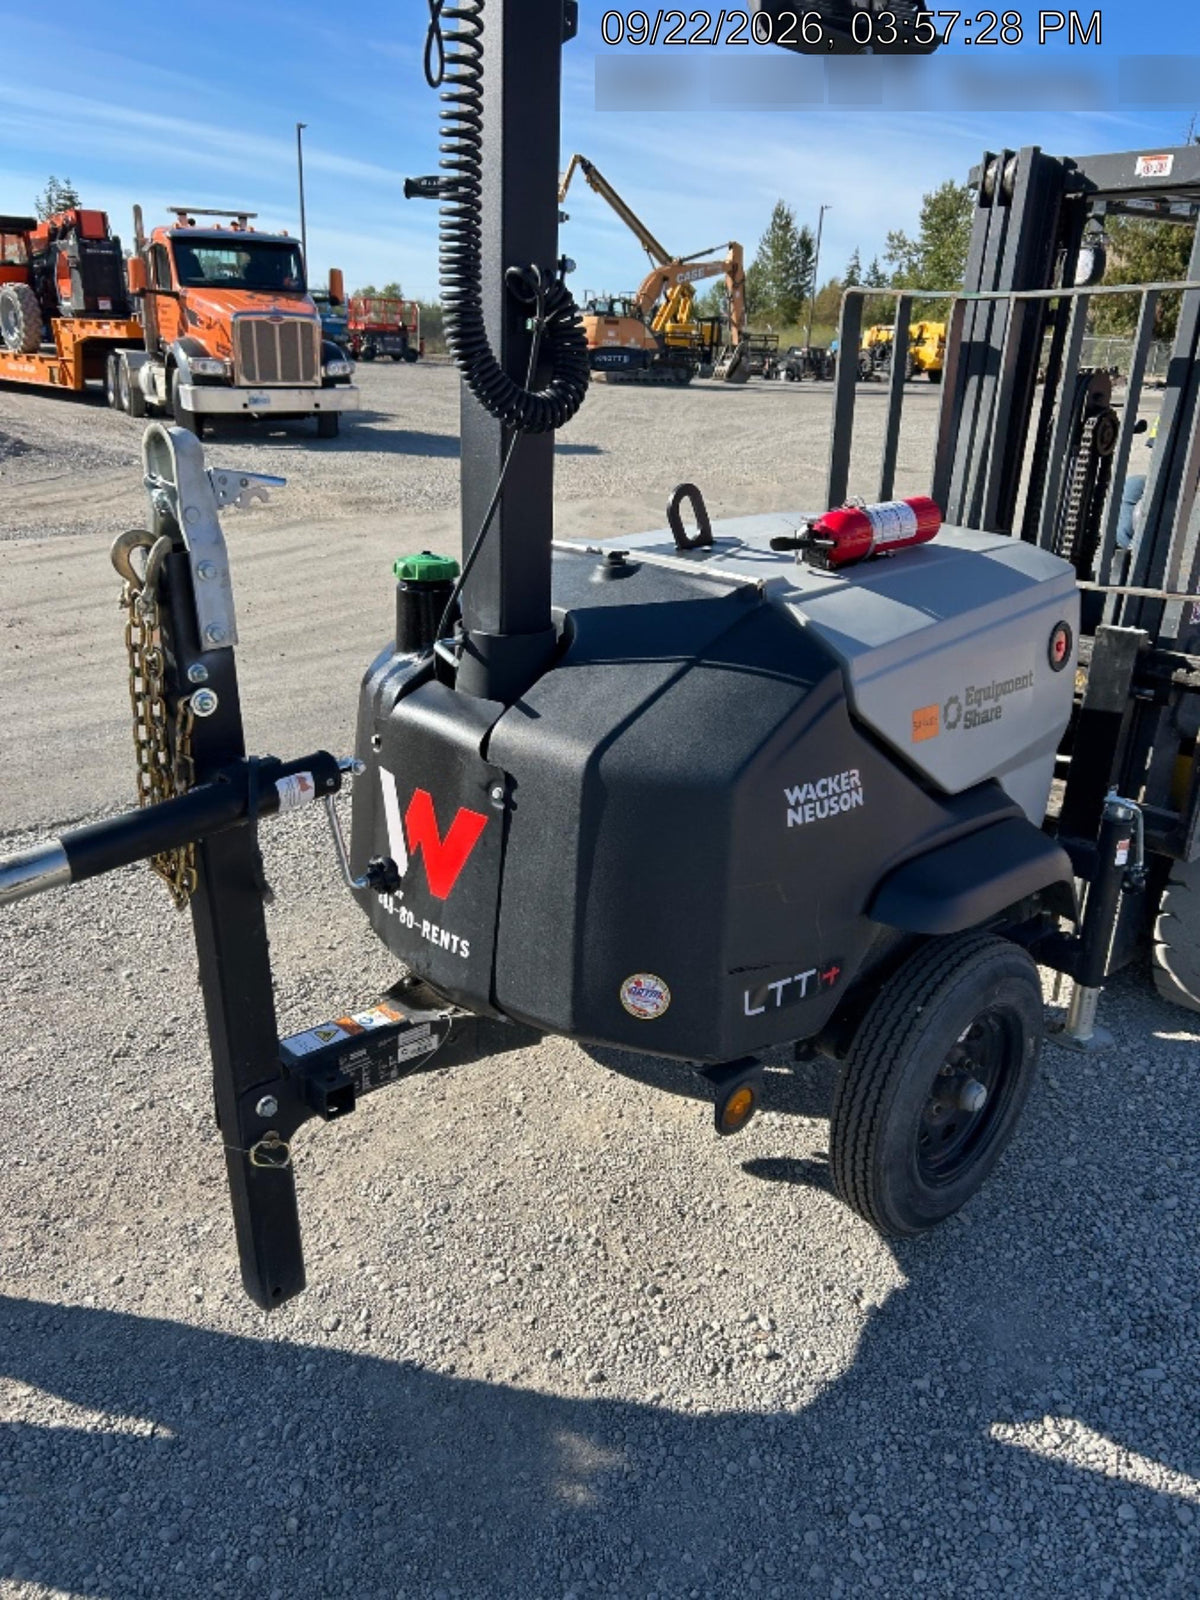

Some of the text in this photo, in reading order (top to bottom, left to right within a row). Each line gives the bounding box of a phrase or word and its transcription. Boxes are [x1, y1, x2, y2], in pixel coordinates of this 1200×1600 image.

[676, 266, 706, 284] CASE
[965, 669, 1034, 708] Equipment
[963, 705, 1002, 730] Share
[784, 769, 861, 807] WACKER
[786, 787, 864, 828] NEUSON
